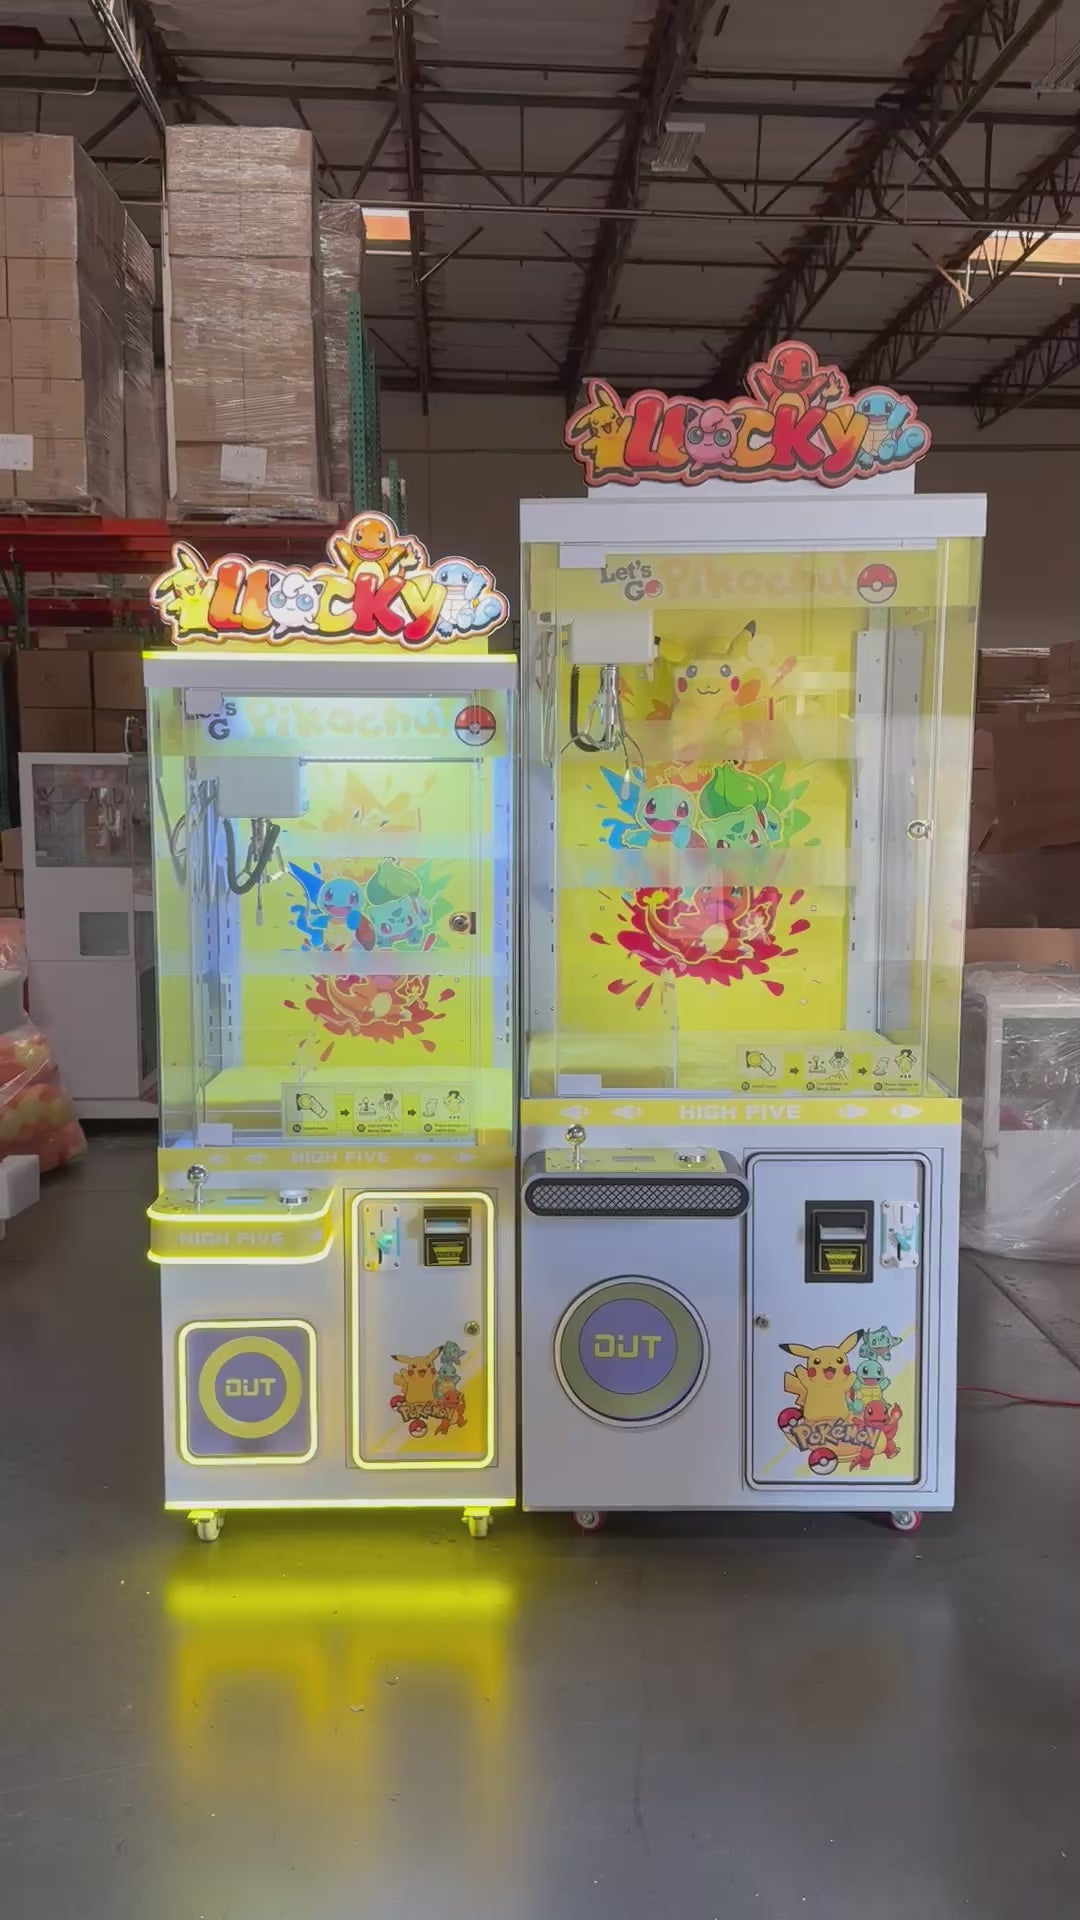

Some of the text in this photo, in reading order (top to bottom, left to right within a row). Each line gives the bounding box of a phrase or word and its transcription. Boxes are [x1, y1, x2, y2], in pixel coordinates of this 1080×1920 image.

[600, 559, 652, 583] Let's
[679, 1102, 801, 1120] HIGH FIVE
[290, 1150, 389, 1165] HIGH FIVE
[179, 1231, 284, 1246] HIGH FIVE
[593, 1333, 663, 1360] OUT
[224, 1377, 277, 1397] OUT
